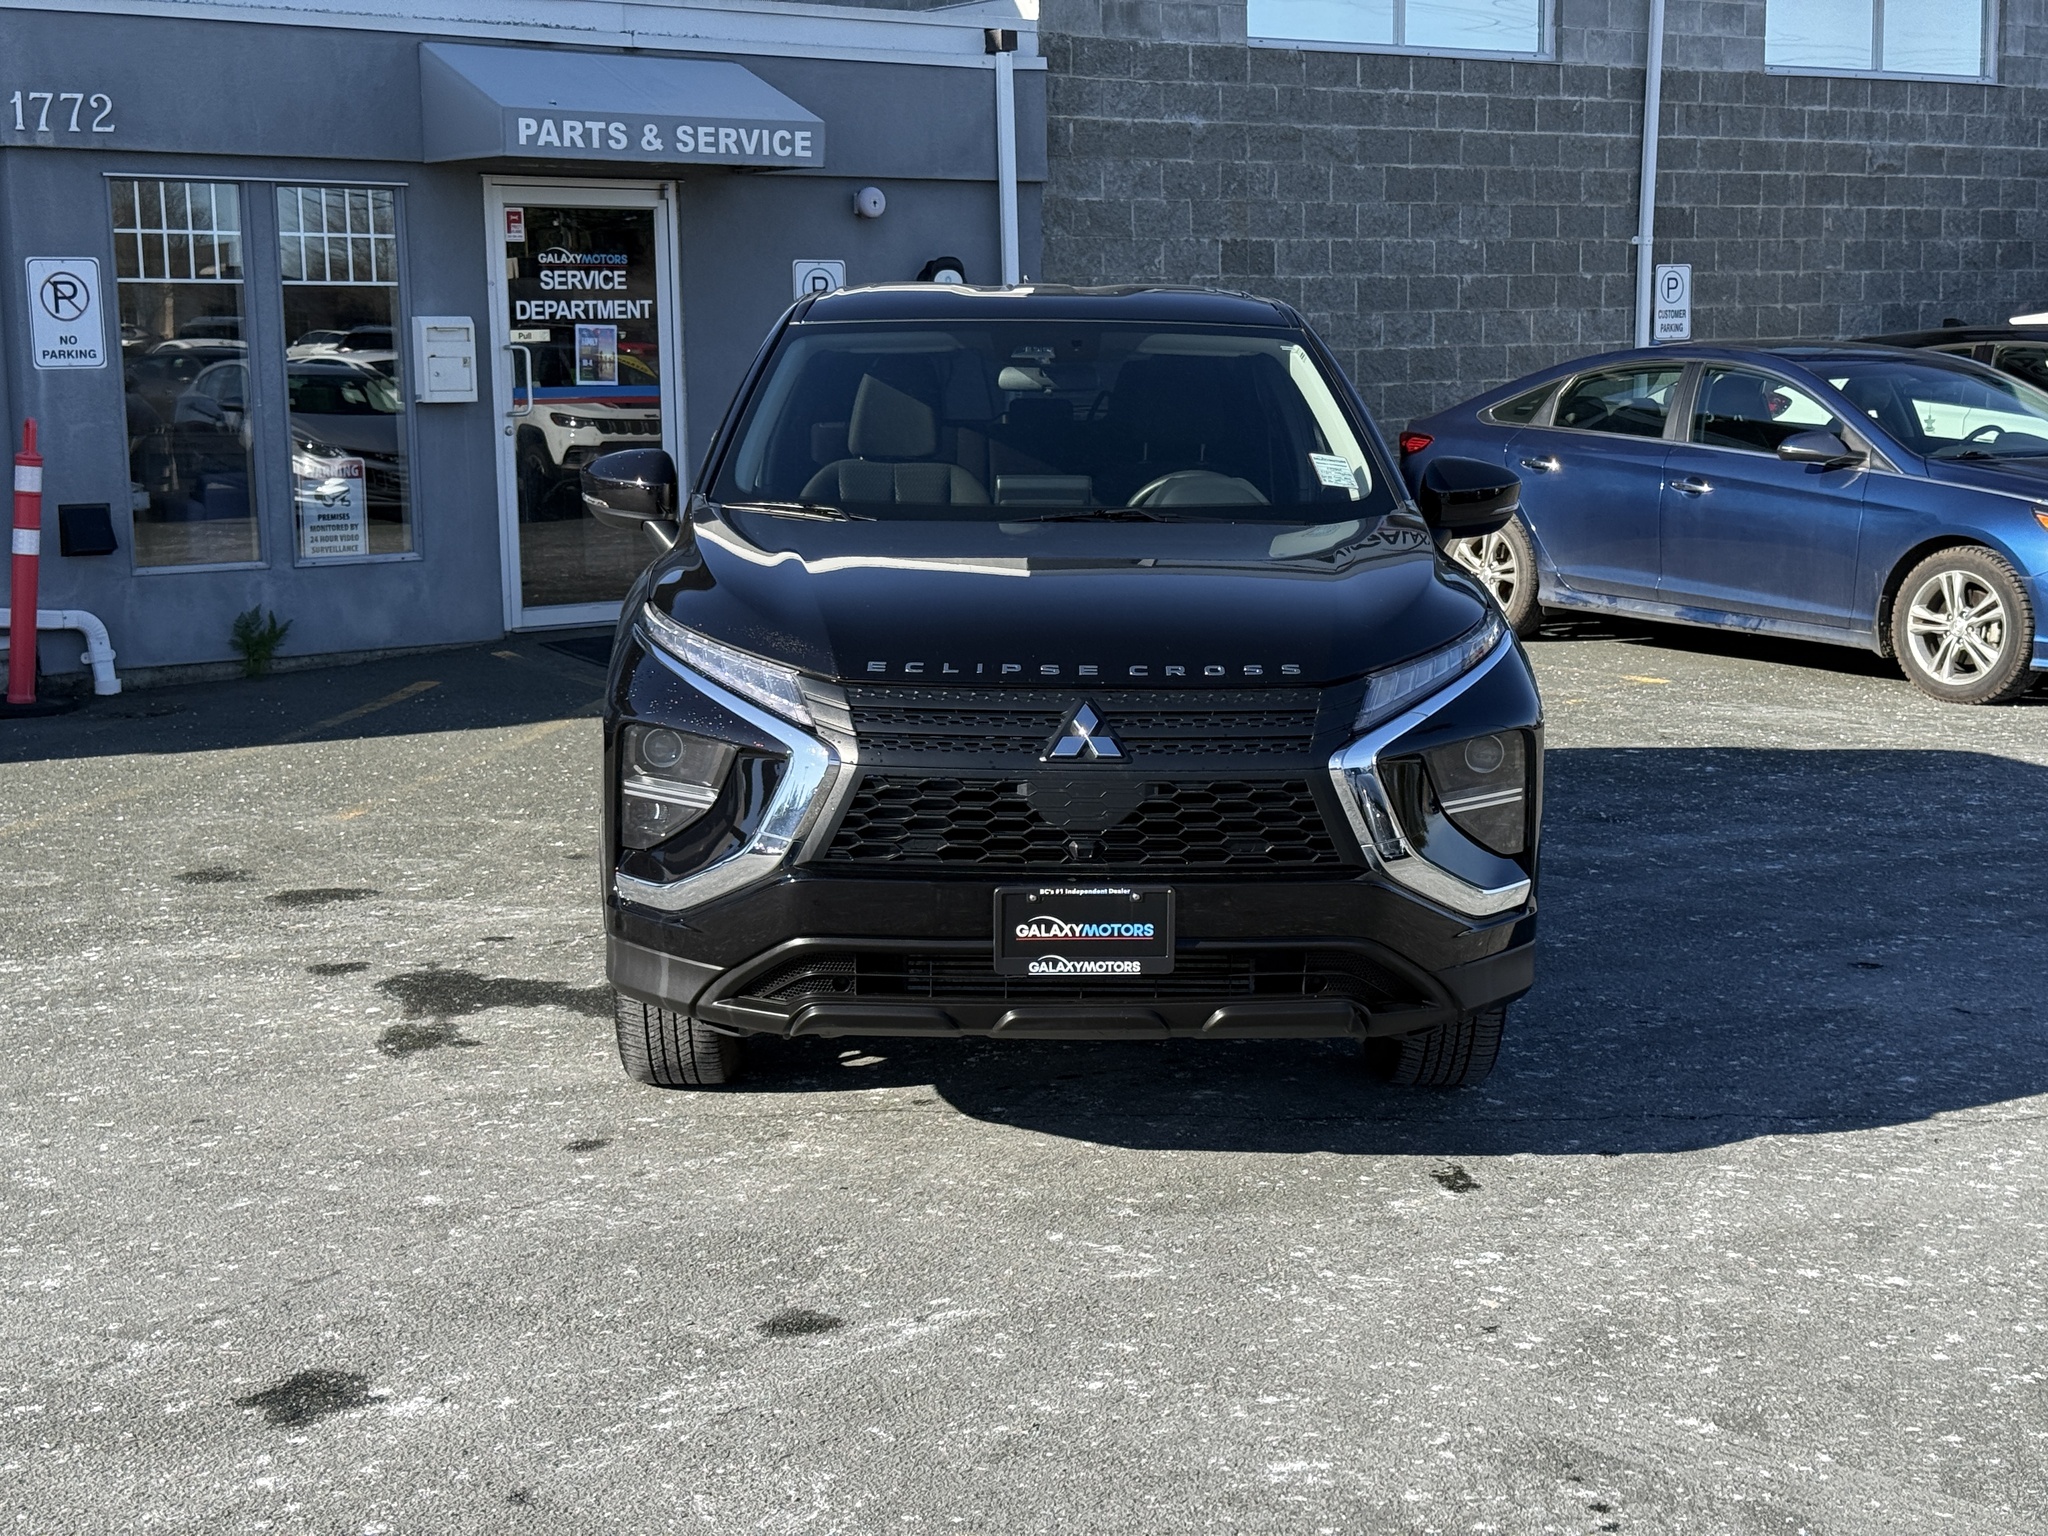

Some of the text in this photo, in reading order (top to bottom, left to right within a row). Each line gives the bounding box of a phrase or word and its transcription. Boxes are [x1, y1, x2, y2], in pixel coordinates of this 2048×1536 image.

[10, 91, 115, 132] 1772
[518, 117, 812, 157] PARTS & SERVICE
[540, 270, 627, 290] SERVICE
[515, 300, 653, 320] DEPARTMENT
[1658, 309, 1687, 319] CUSTOMER
[1660, 323, 1683, 333] PARKING
[60, 335, 78, 345] NO
[518, 331, 532, 340] Pull
[42, 349, 97, 359] PARKING
[317, 512, 350, 521] PREMISES
[309, 523, 359, 533] MONITORED BY
[310, 534, 360, 543] 24 HOUR VIDEO
[311, 544, 359, 554] SURVEILLANCE
[867, 661, 1301, 676] ECLIPSE CROSS
[1064, 887, 1108, 896] Independent
[1108, 887, 1131, 895] Dealer
[1015, 922, 1154, 938] GALAXYMOTORS
[1028, 960, 1141, 973] GALAXYMOTORS
